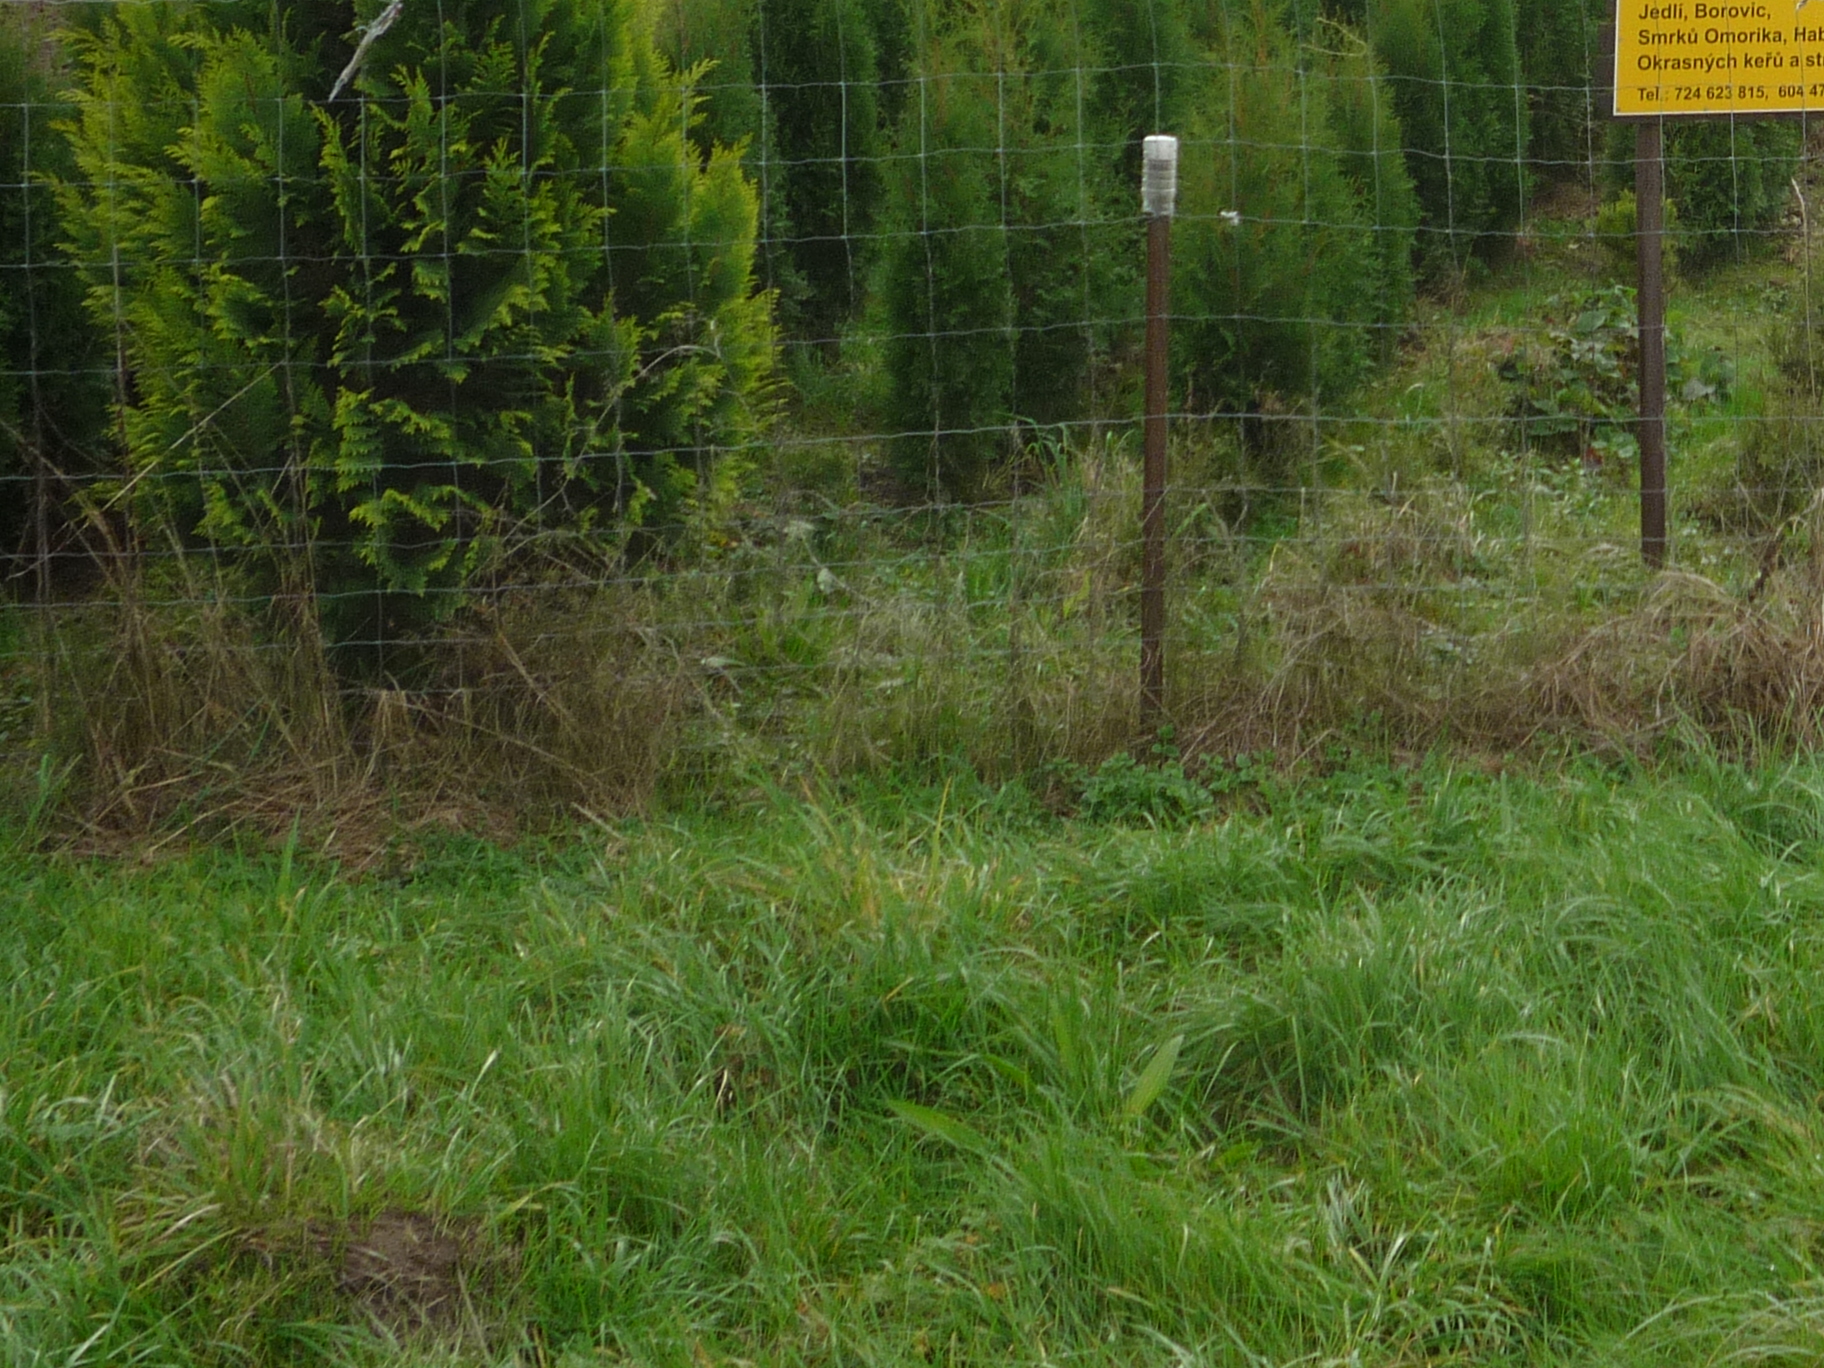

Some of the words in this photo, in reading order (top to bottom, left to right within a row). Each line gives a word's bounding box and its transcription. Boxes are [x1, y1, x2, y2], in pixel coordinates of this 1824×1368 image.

[1639, 2, 1688, 22] Jedlí,
[1695, 2, 1772, 19] Borovic,
[1638, 28, 1698, 45] Smrků
[1705, 27, 1787, 45] Omorika,
[1637, 54, 1737, 72] Okrasných
[1743, 51, 1784, 68] keřů
[1790, 56, 1801, 67] a
[1674, 86, 1704, 100] 724
[1706, 86, 1733, 100] 623
[1737, 86, 1769, 101] 815,
[1778, 85, 1804, 98] 604
